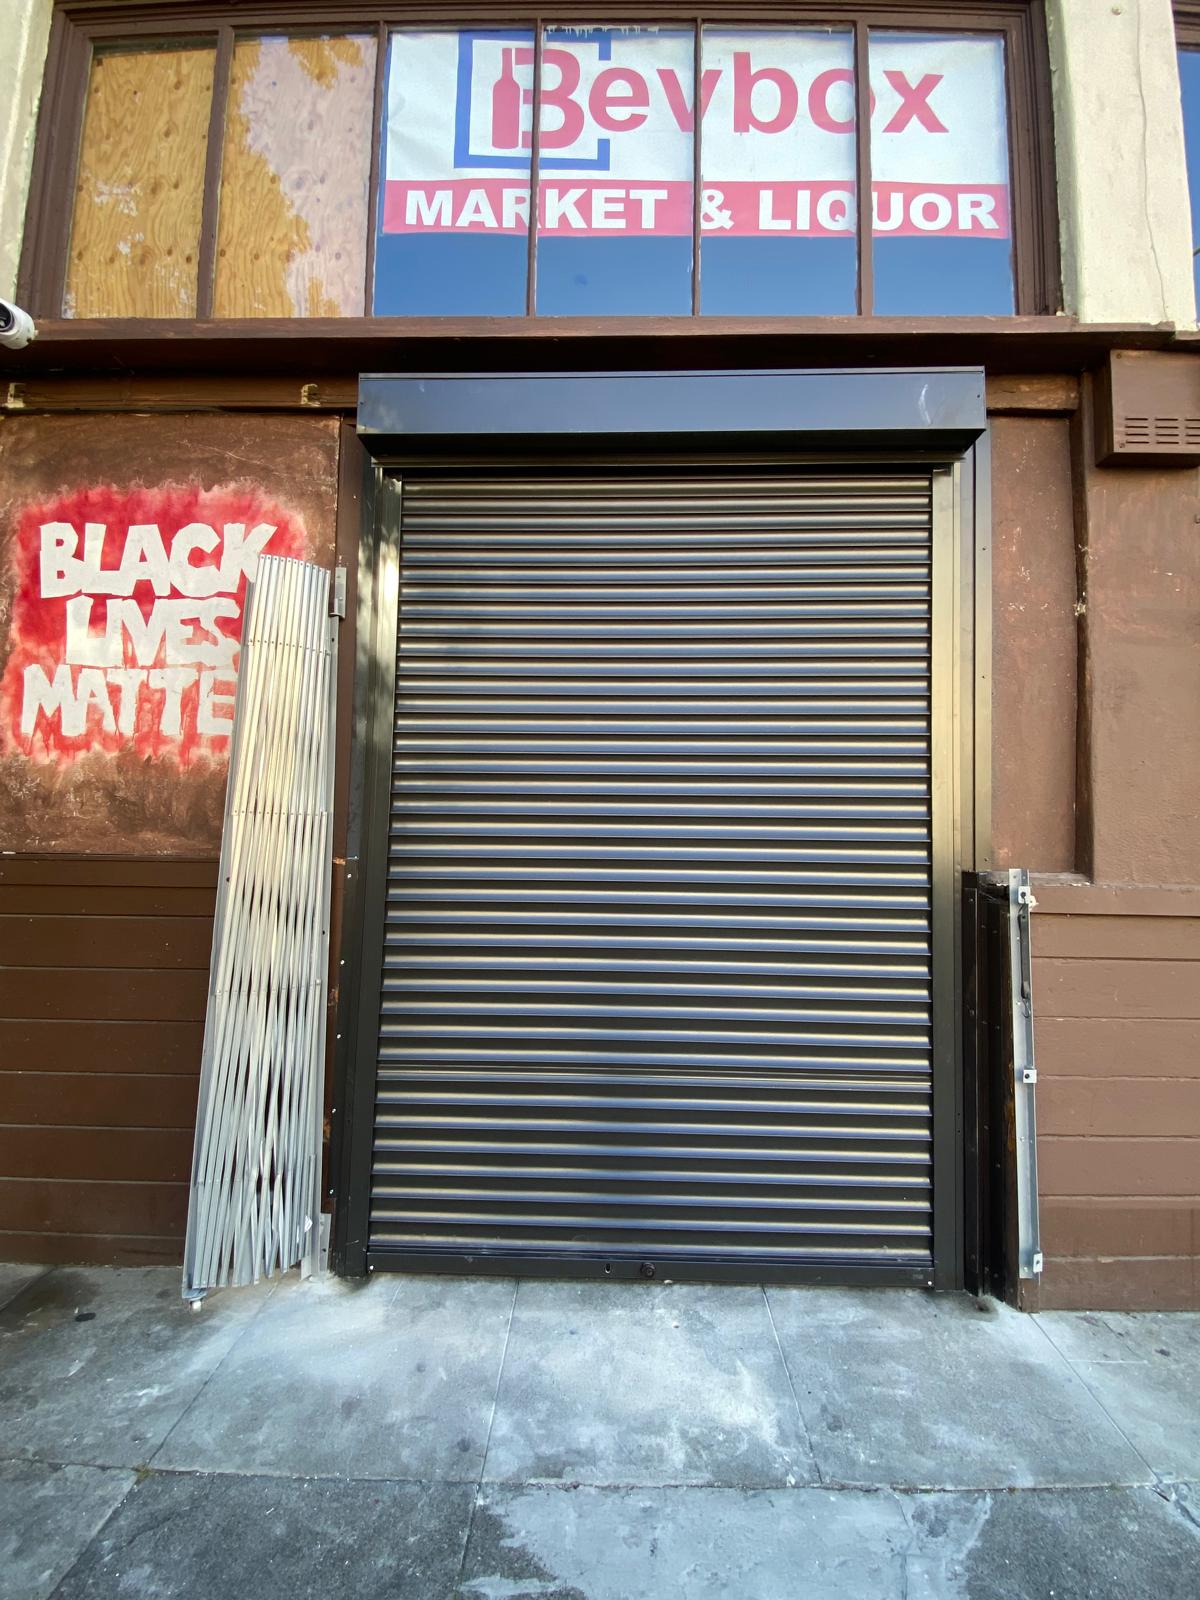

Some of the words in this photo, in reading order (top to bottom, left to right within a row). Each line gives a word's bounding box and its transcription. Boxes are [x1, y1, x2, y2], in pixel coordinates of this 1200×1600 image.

[491, 48, 950, 150] Bevbox
[405, 188, 668, 230] MARKET
[700, 188, 734, 231] &
[758, 189, 1000, 231] LIQUOR
[40, 522, 278, 598] BLACK
[66, 595, 241, 668] LIVES
